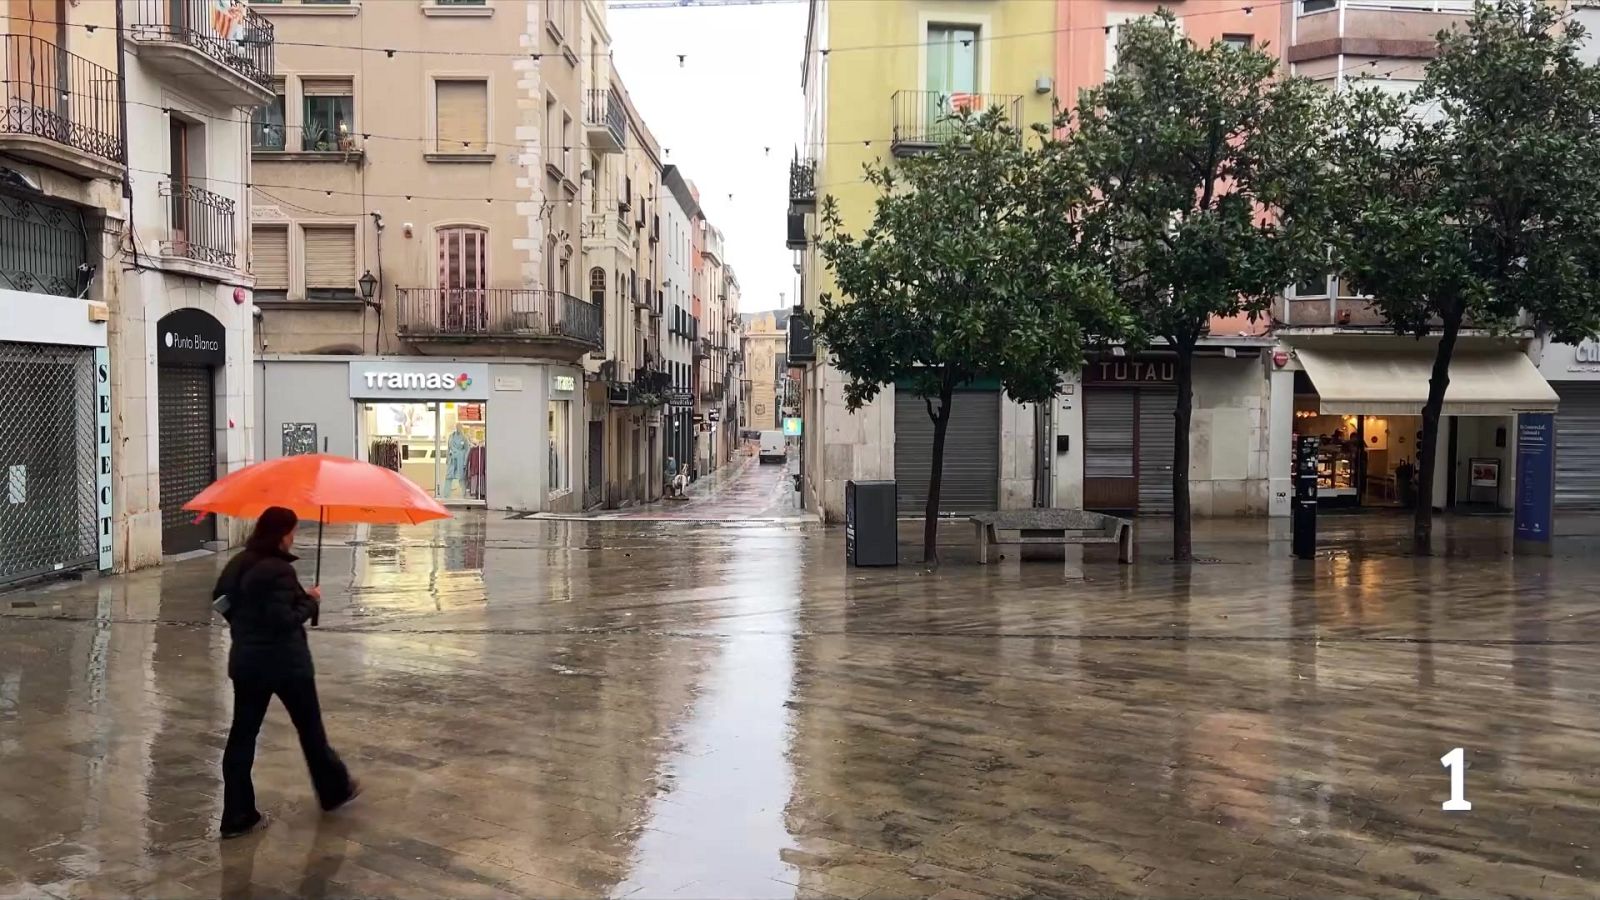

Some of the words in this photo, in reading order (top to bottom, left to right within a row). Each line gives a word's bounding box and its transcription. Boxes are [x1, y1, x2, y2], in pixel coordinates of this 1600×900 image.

[174, 332, 194, 349] Punto
[194, 334, 219, 351] Blanco
[363, 371, 456, 389] Tramas
[1100, 362, 1174, 380] TUTAU
[98, 363, 112, 536] SELECT
